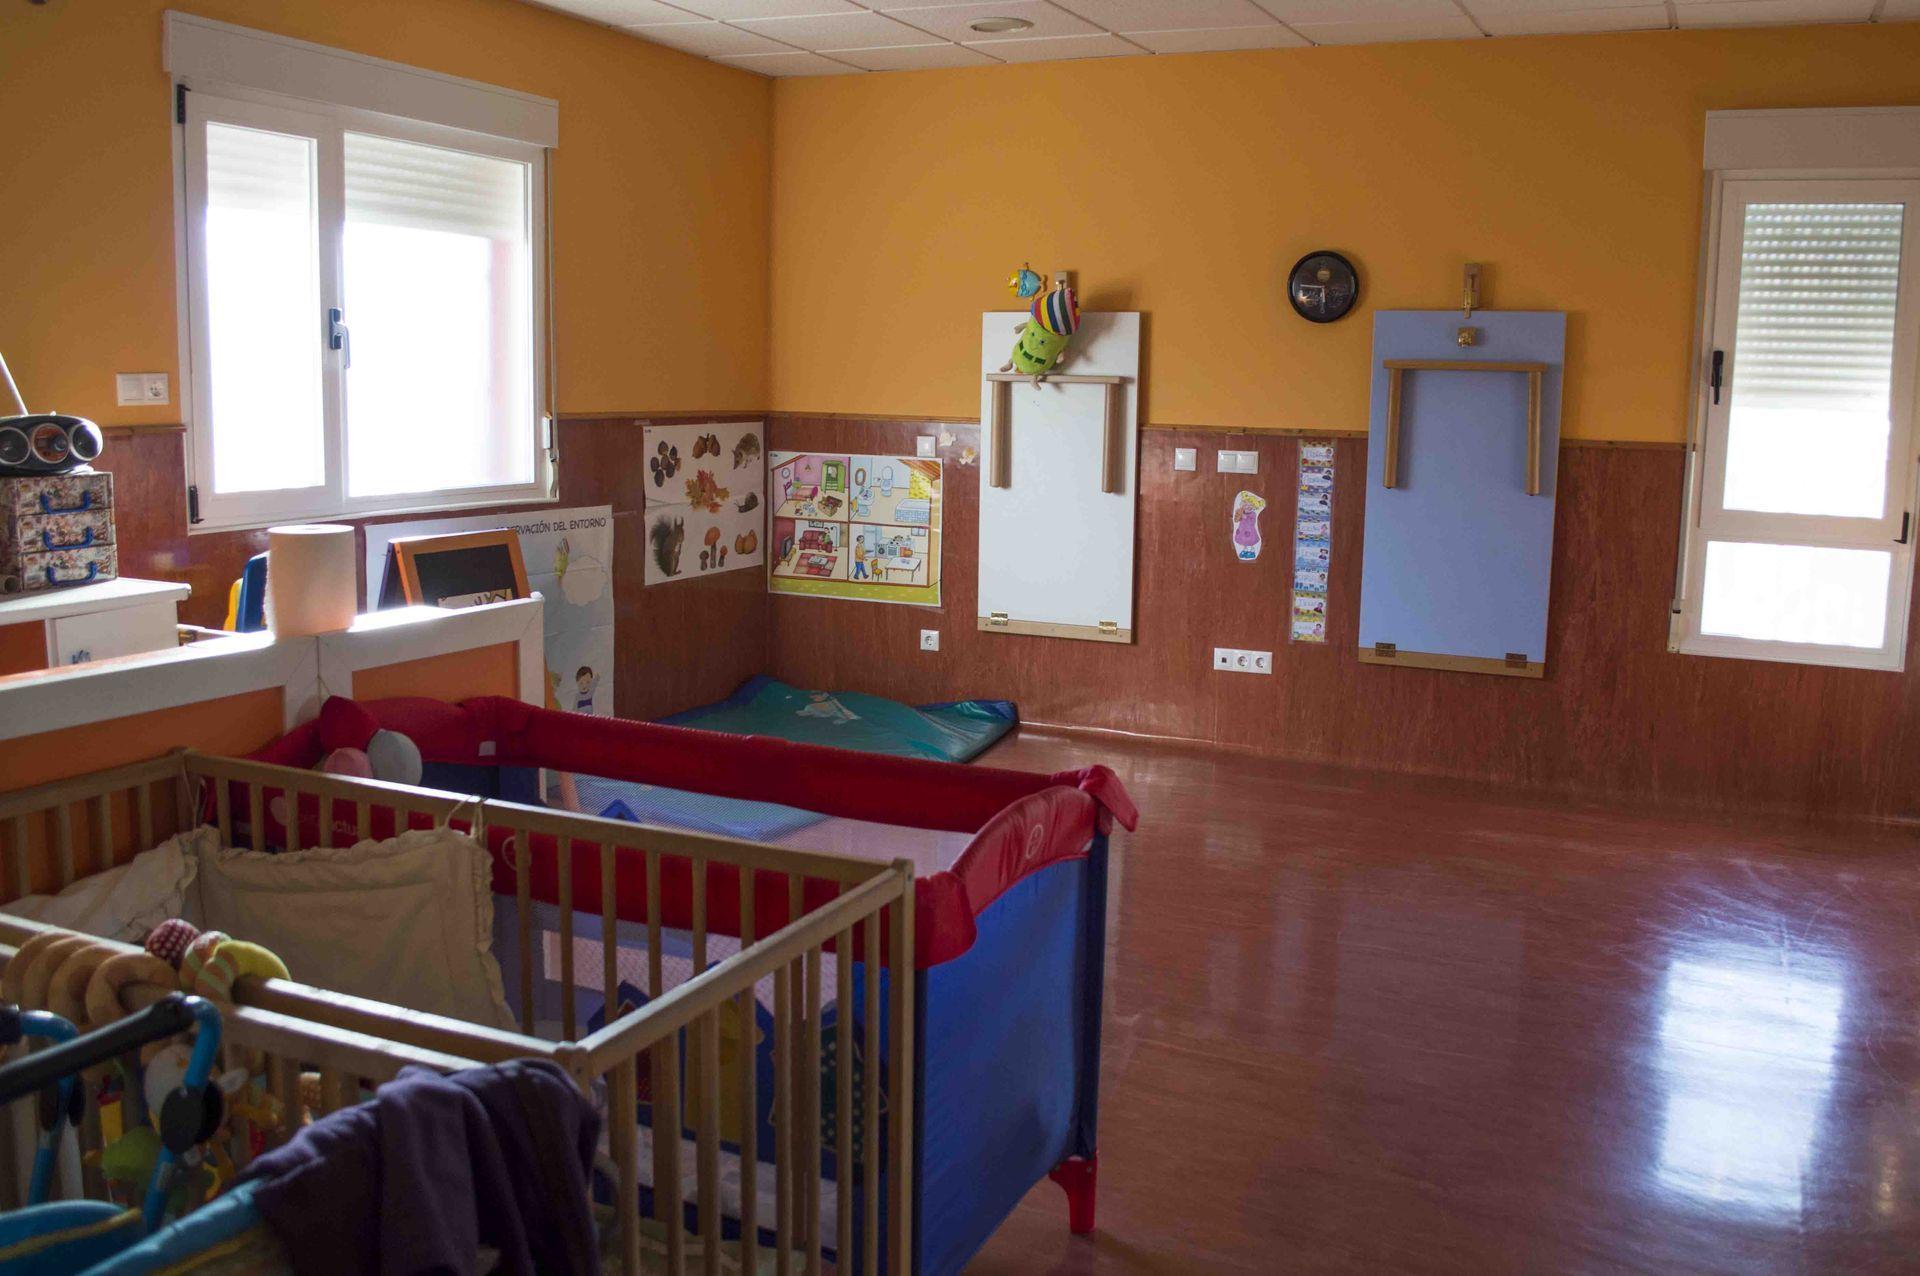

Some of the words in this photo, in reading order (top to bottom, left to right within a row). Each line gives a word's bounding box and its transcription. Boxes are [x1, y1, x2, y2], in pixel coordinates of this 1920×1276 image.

[496, 520, 551, 535] RVACIÓN
[553, 521, 567, 532] DEL
[569, 517, 606, 530] ENTORNO
